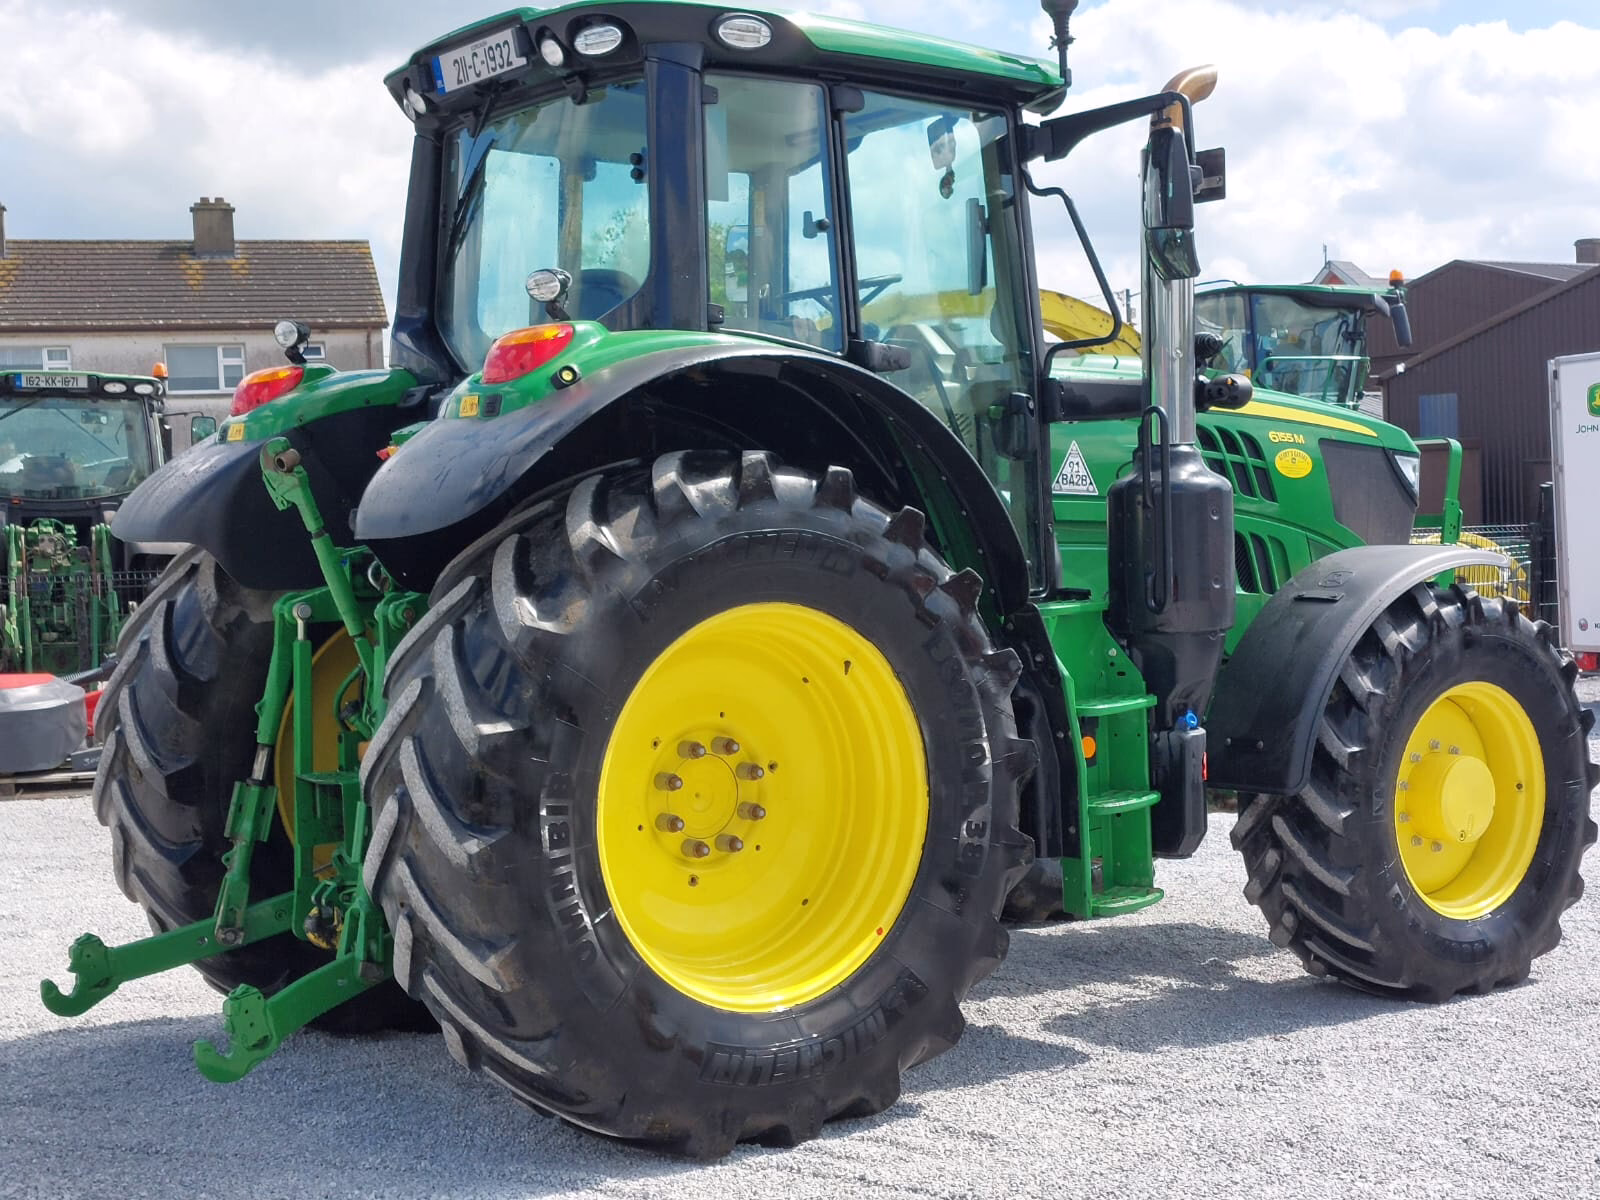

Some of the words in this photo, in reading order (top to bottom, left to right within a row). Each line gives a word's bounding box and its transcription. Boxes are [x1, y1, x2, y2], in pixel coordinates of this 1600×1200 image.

[453, 39, 513, 86] 211-C-1932
[25, 375, 79, 387] 162-KK-1671
[1575, 423, 1599, 434] JOHN
[1068, 461, 1080, 473] 91
[1061, 473, 1088, 486] BA2B
